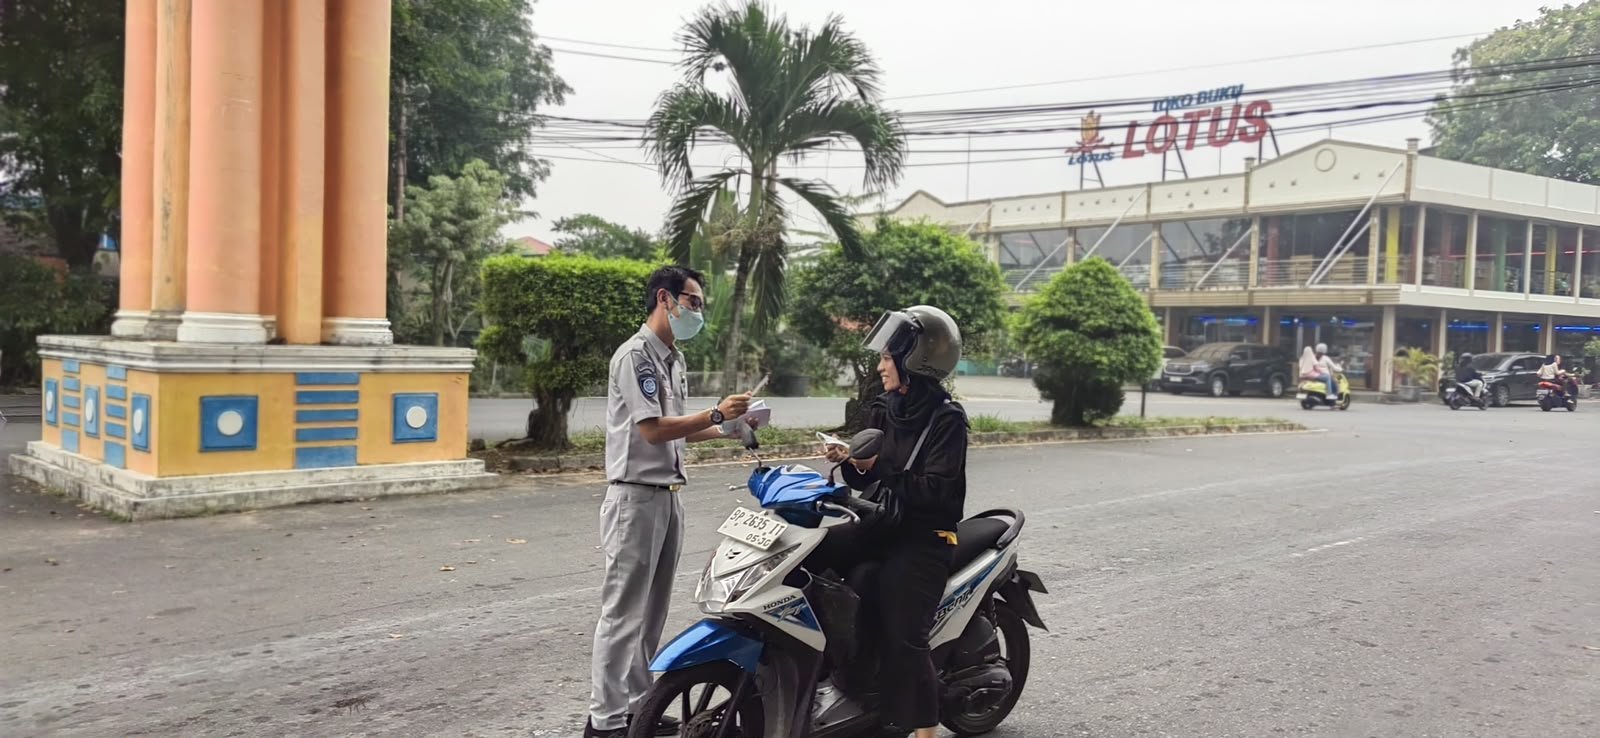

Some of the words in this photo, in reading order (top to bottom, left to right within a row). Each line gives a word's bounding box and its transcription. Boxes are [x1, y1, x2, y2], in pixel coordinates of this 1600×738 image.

[1122, 99, 1273, 159] LOTUS
[743, 513, 770, 530] 2635
[763, 595, 797, 610] HONDA
